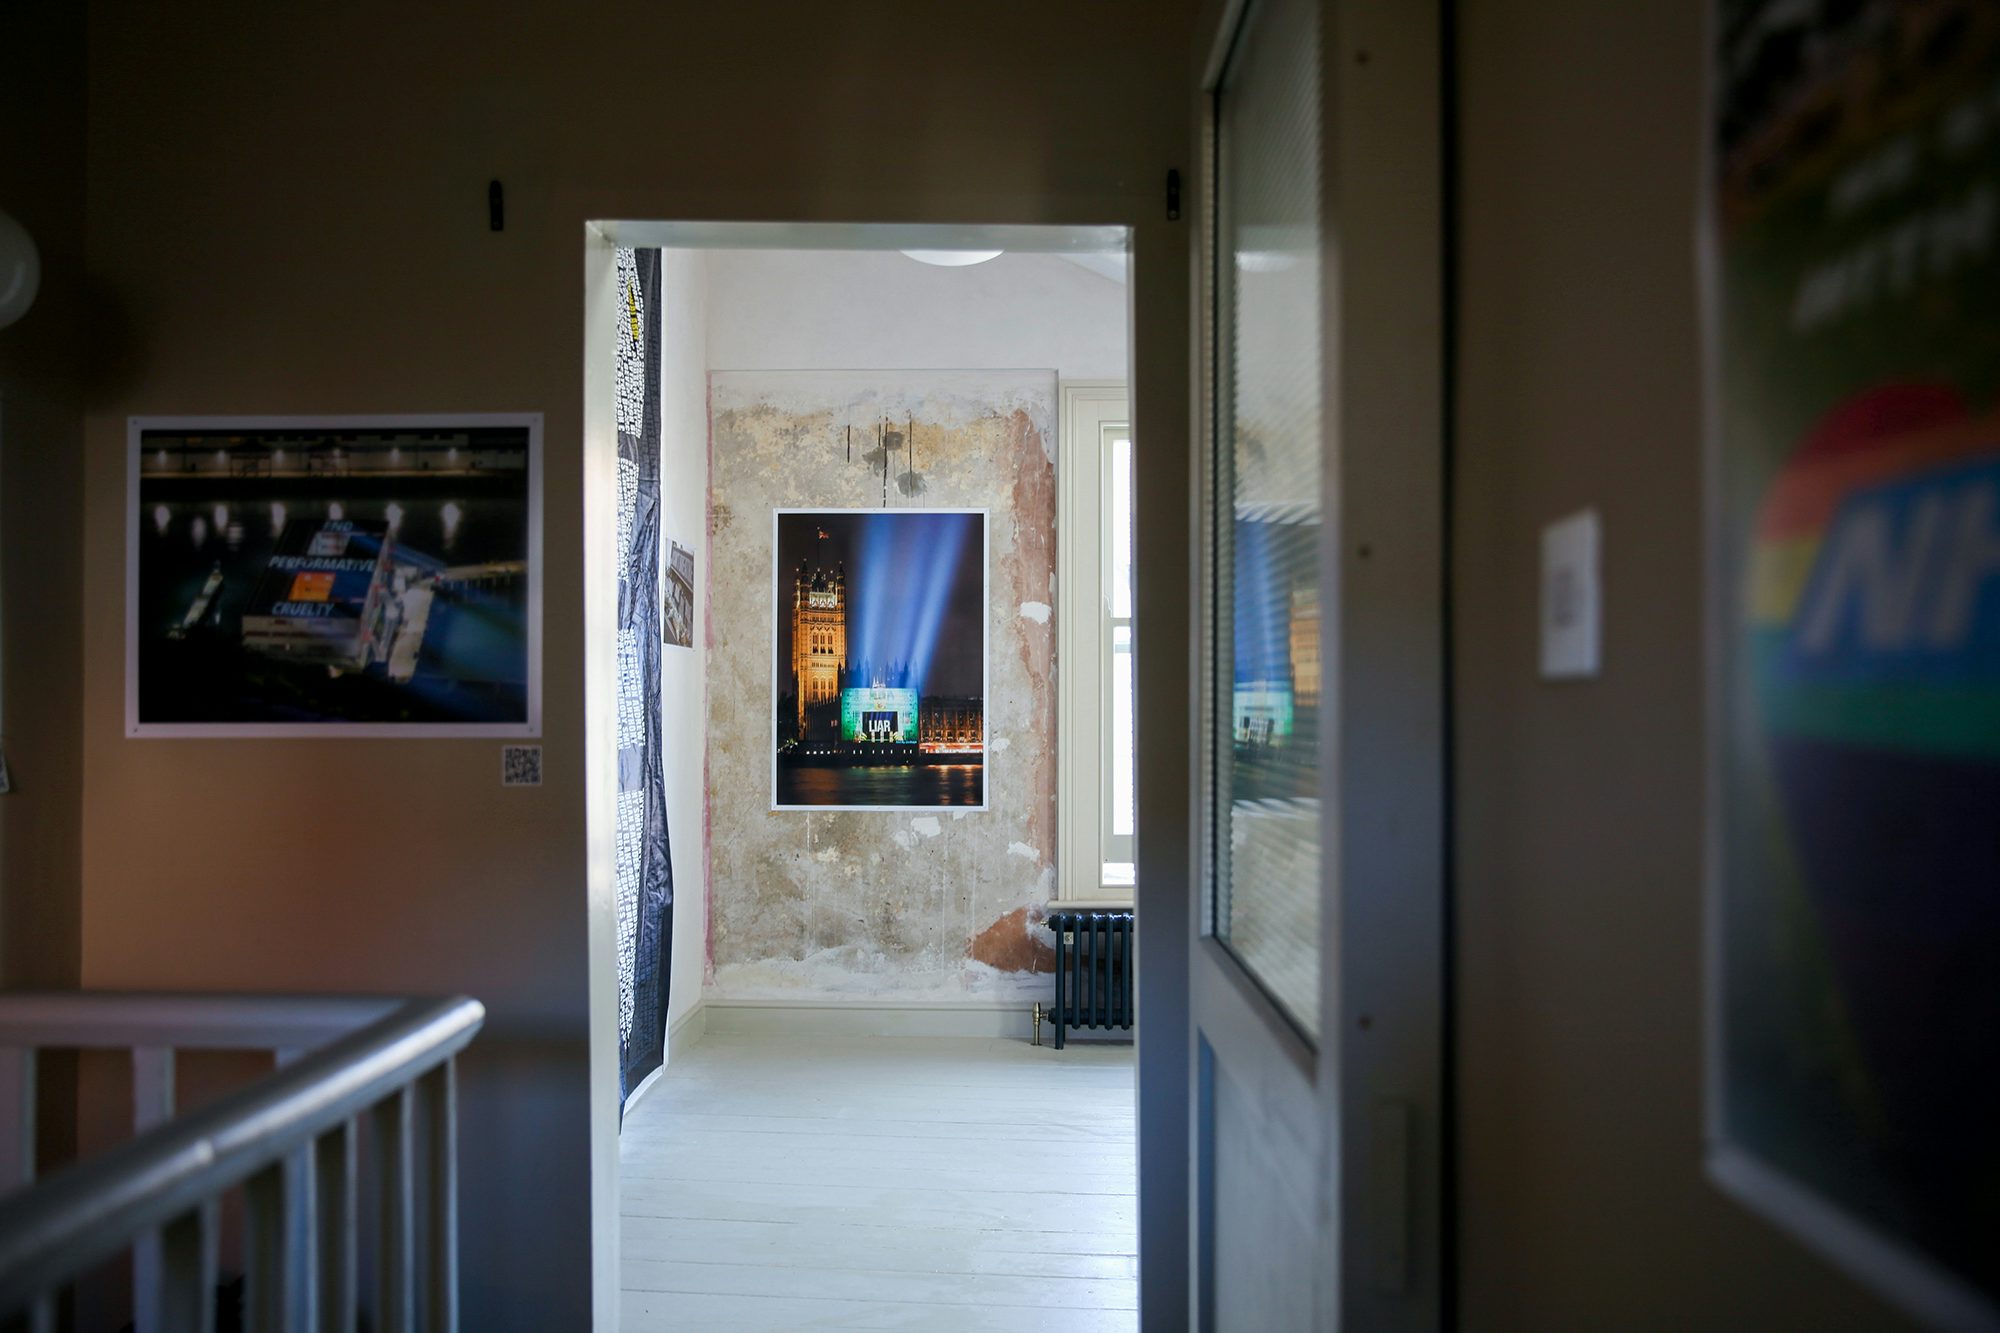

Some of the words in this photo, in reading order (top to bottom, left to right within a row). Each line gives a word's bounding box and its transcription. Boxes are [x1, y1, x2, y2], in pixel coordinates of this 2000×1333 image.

[267, 555, 377, 573] PERFORMATIVE
[271, 601, 336, 617] CRUELTY
[868, 719, 891, 732] LIAR
